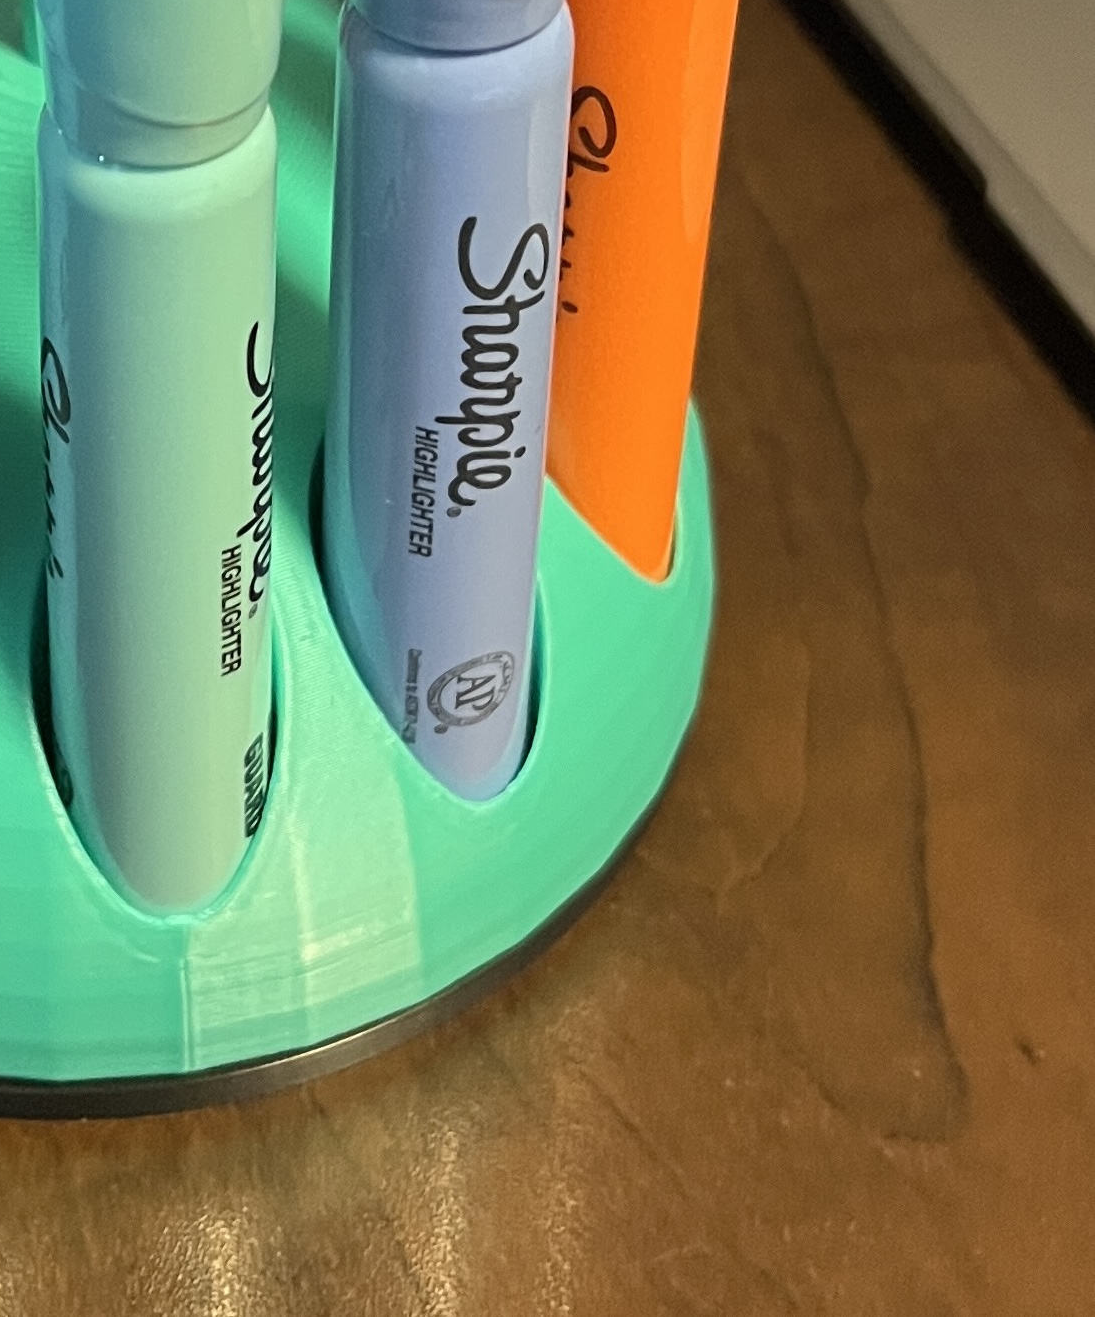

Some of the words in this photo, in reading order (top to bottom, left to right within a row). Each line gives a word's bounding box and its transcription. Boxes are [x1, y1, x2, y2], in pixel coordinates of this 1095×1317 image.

[435, 216, 550, 509] Sharpie
[408, 426, 440, 558] HIGHLIGHTER
[221, 544, 243, 677] HIGHLIGHTER
[454, 674, 497, 710] AP
